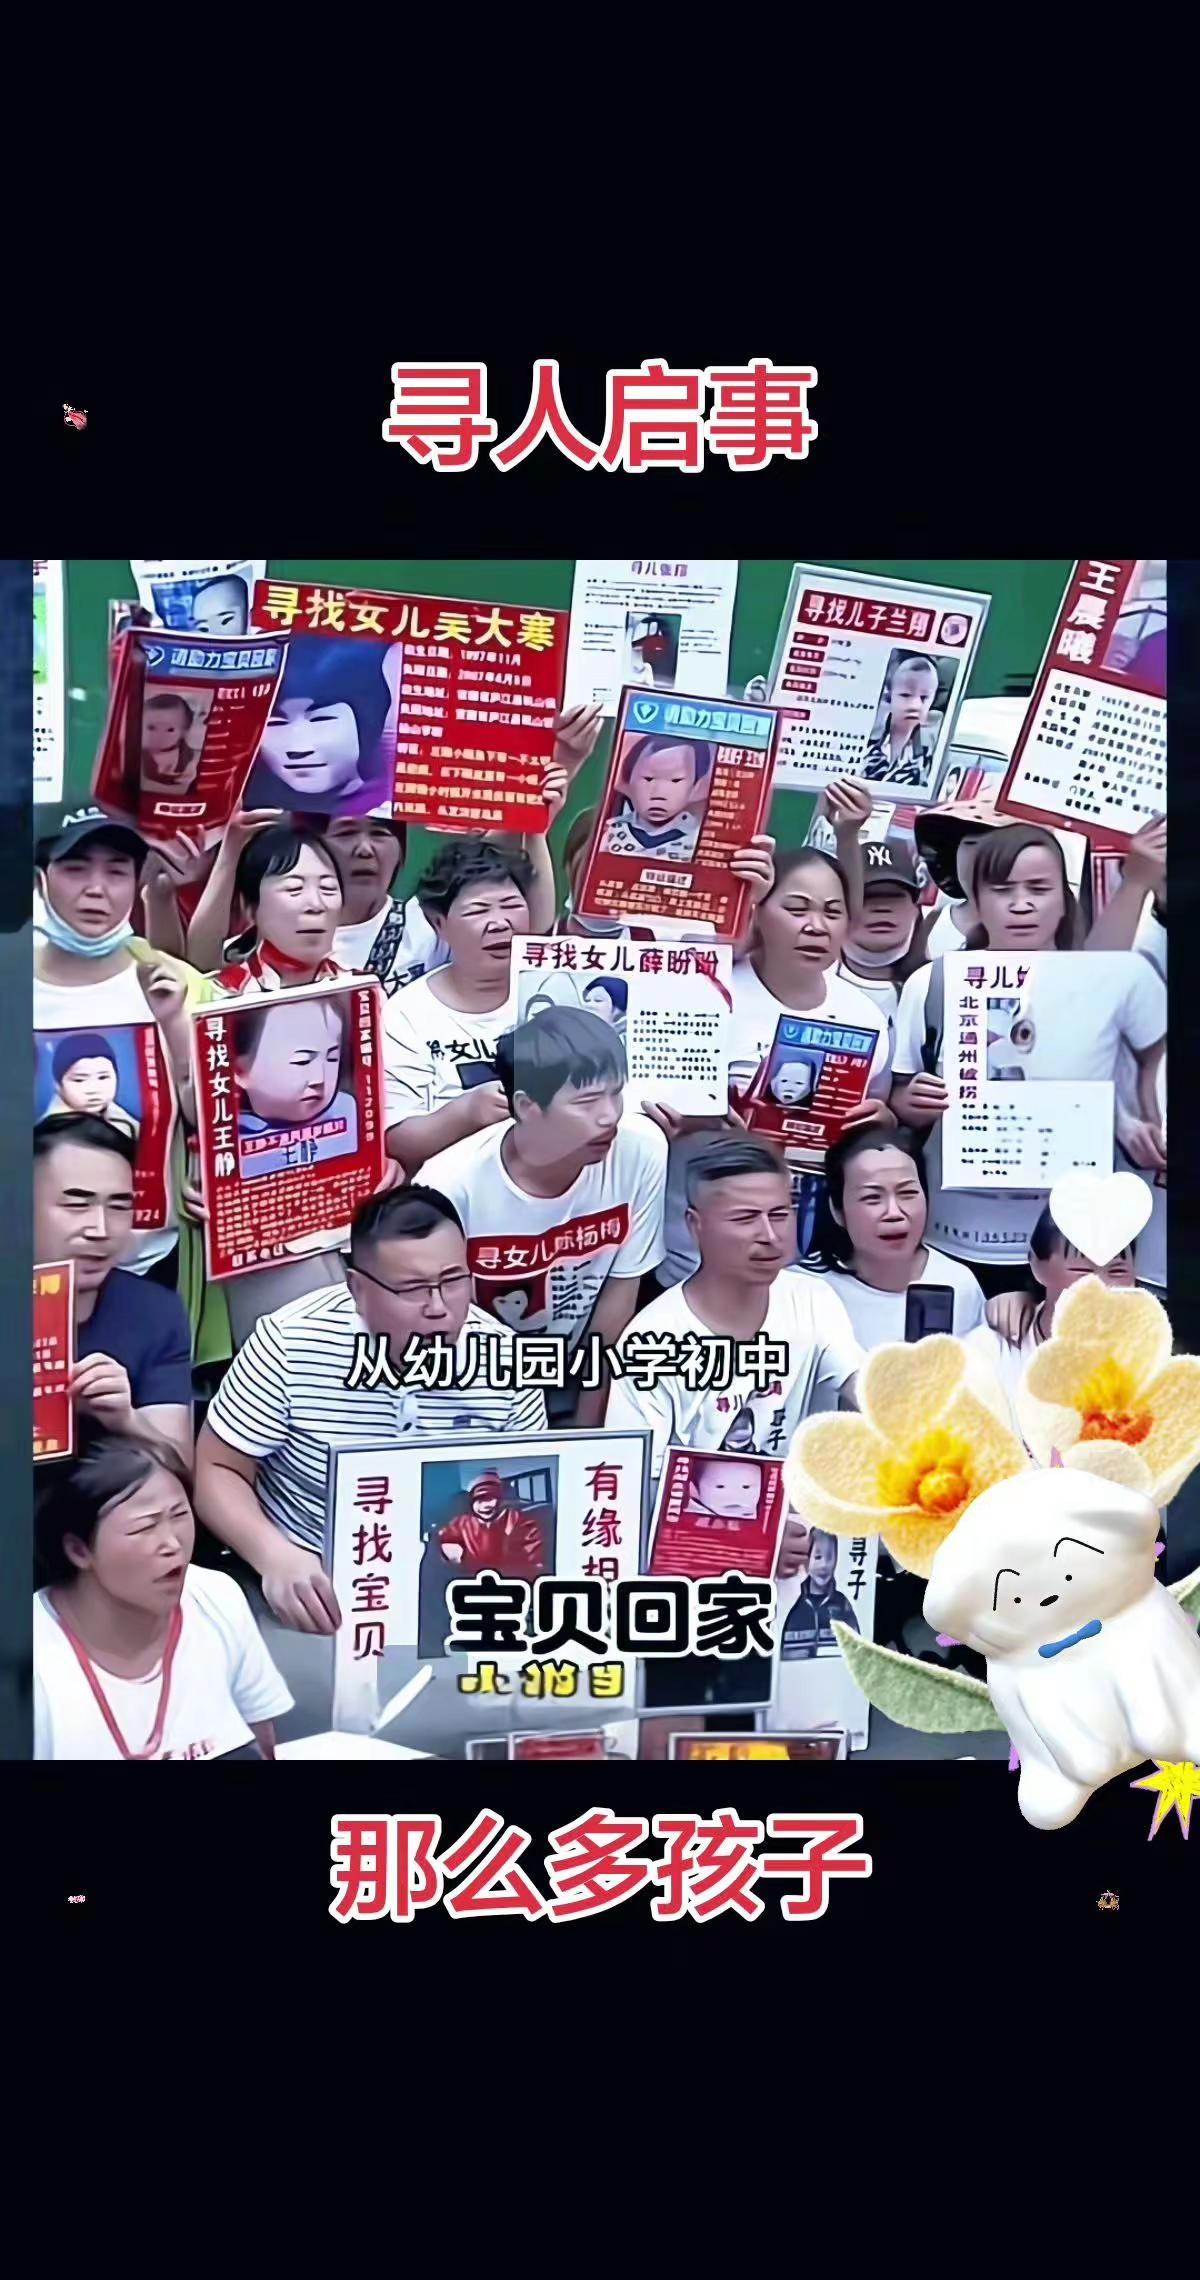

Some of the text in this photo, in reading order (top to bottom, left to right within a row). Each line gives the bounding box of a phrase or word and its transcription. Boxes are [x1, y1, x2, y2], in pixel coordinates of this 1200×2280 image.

[522, 942, 719, 975] 寻找女儿薛盼盼
[352, 1476, 393, 1660] 寻找宝贝
